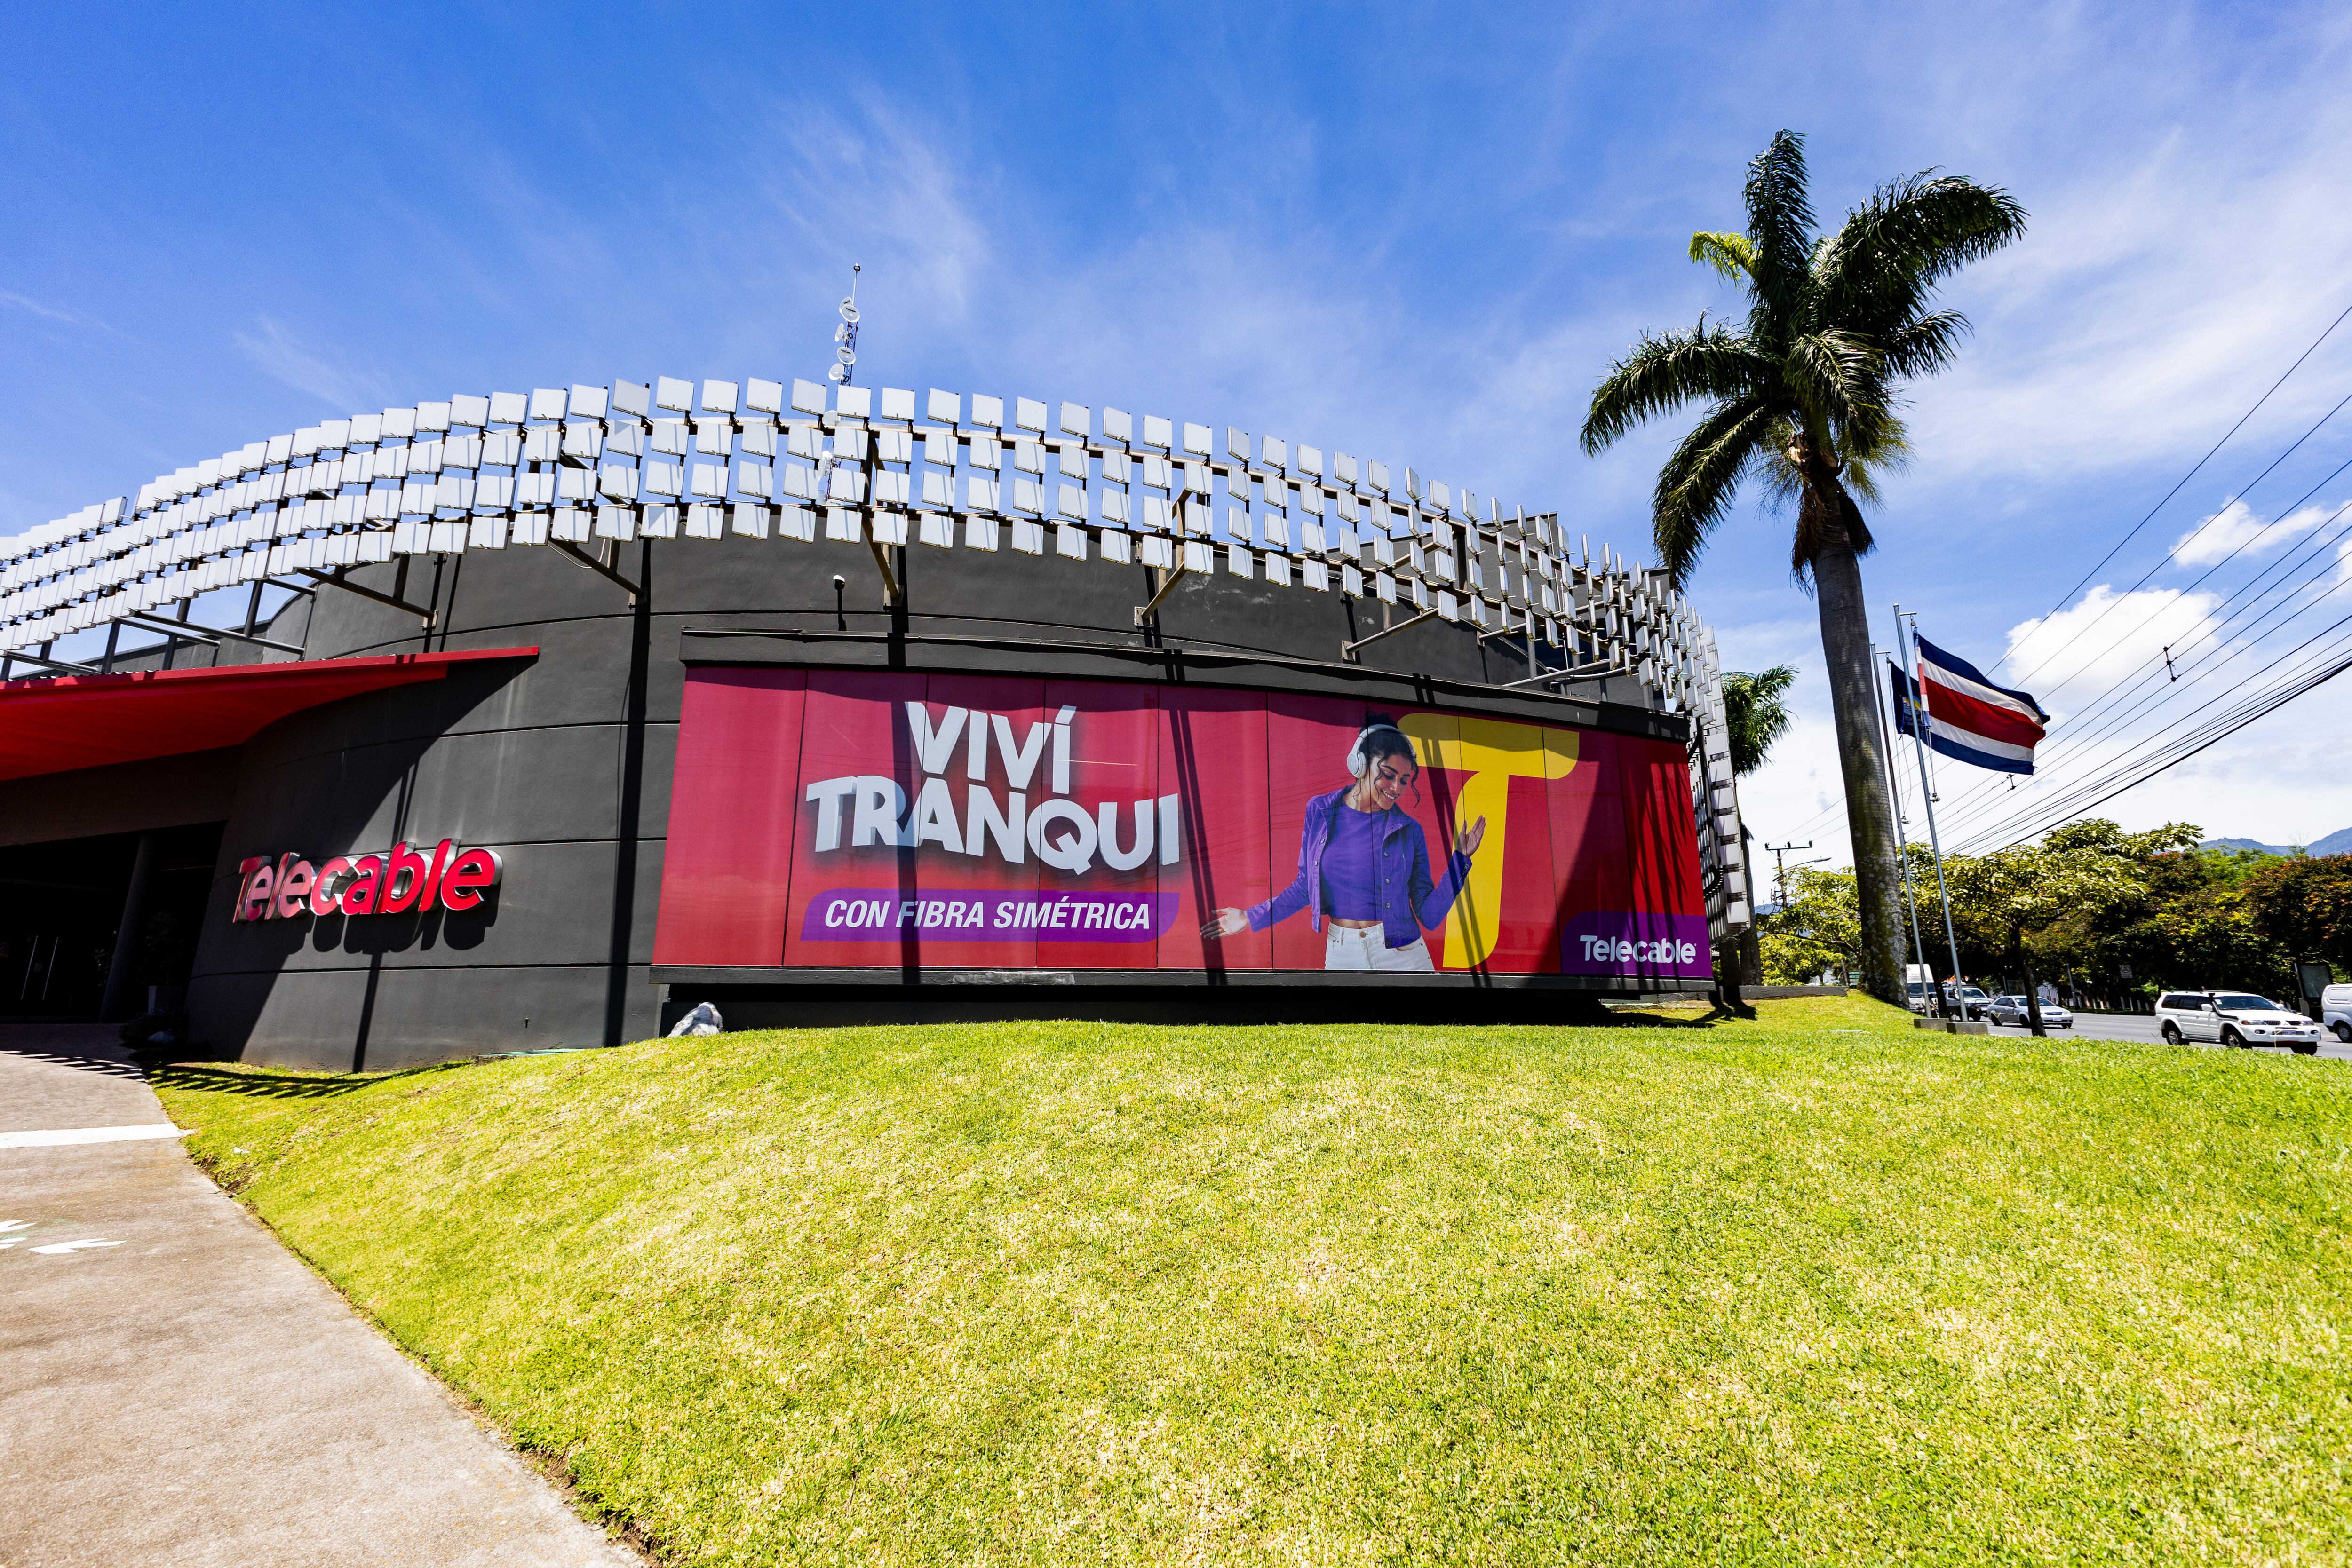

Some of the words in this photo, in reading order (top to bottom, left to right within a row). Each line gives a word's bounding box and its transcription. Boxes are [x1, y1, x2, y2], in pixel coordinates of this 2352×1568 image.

[904, 701, 1078, 795] VIVÍ
[806, 775, 1179, 875] TRANQUI
[233, 838, 503, 923] Telecable
[825, 899, 891, 928] CON
[896, 899, 984, 928] FIBRA
[993, 896, 1150, 930] SIMÉTRICA
[1580, 934, 1696, 964] Telecable
